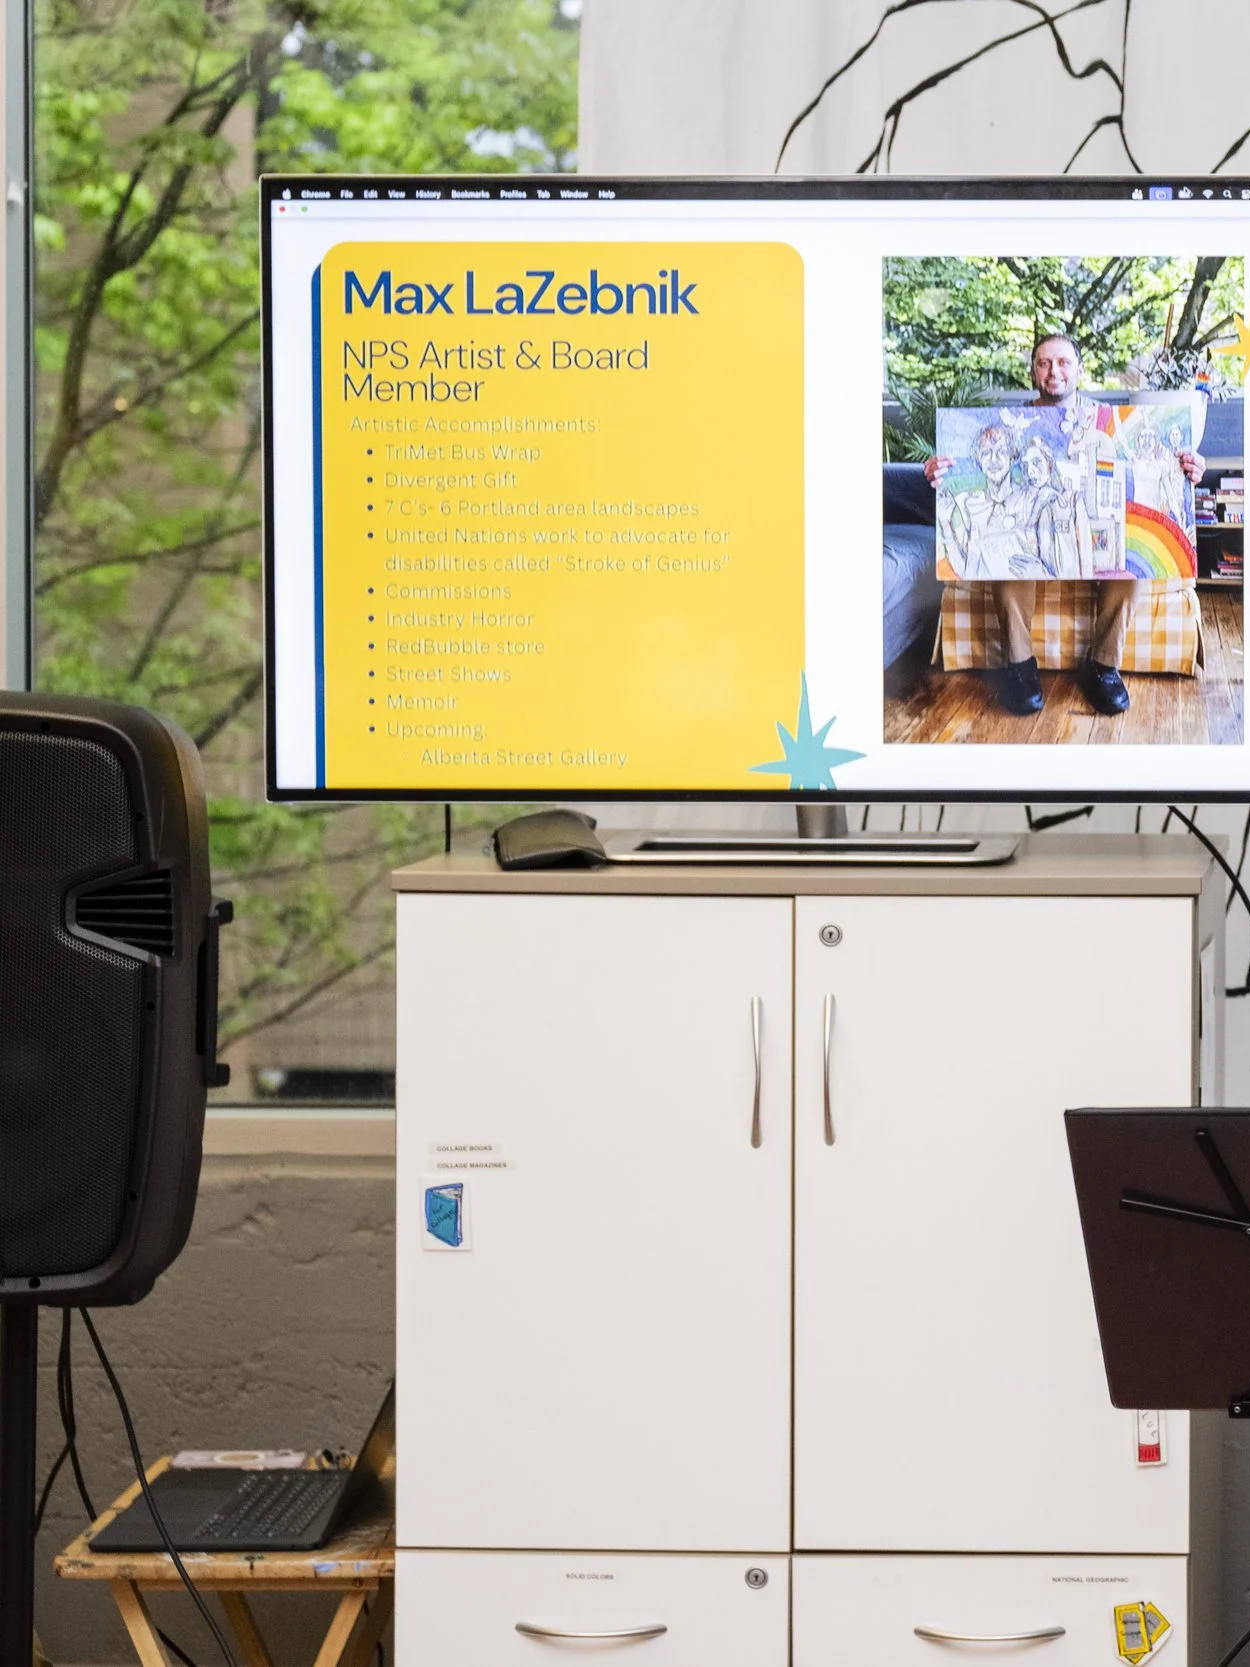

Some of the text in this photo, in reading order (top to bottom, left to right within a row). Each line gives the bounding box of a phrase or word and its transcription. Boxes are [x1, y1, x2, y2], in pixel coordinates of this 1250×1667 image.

[300, 189, 615, 200] Chrome File Edit View History Bookmarks Profiles Tab Window Help
[344, 269, 700, 315] Max LaZebnik
[344, 339, 649, 370] NPS Artist & Board
[344, 372, 485, 402] Member
[350, 415, 601, 436] Artistic Accomplishments:
[384, 443, 542, 464] TriMet Bus Wrap
[384, 471, 518, 492] Divergent Gift
[385, 499, 395, 515] 7
[440, 500, 451, 517] 6
[459, 499, 540, 517] Portland
[546, 502, 586, 516] area
[592, 499, 700, 520] landscapes
[385, 527, 731, 545] United Nations work to advocate for
[385, 554, 488, 572] disabilities
[493, 554, 550, 572] called
[632, 554, 650, 573] of
[386, 582, 512, 600] Commissions
[386, 610, 535, 631] Industry Horror
[386, 637, 545, 655] RedBubble store
[386, 665, 512, 683] Street Shows
[386, 693, 459, 710] Memoir
[420, 748, 629, 770] Alberta Street Gallery
